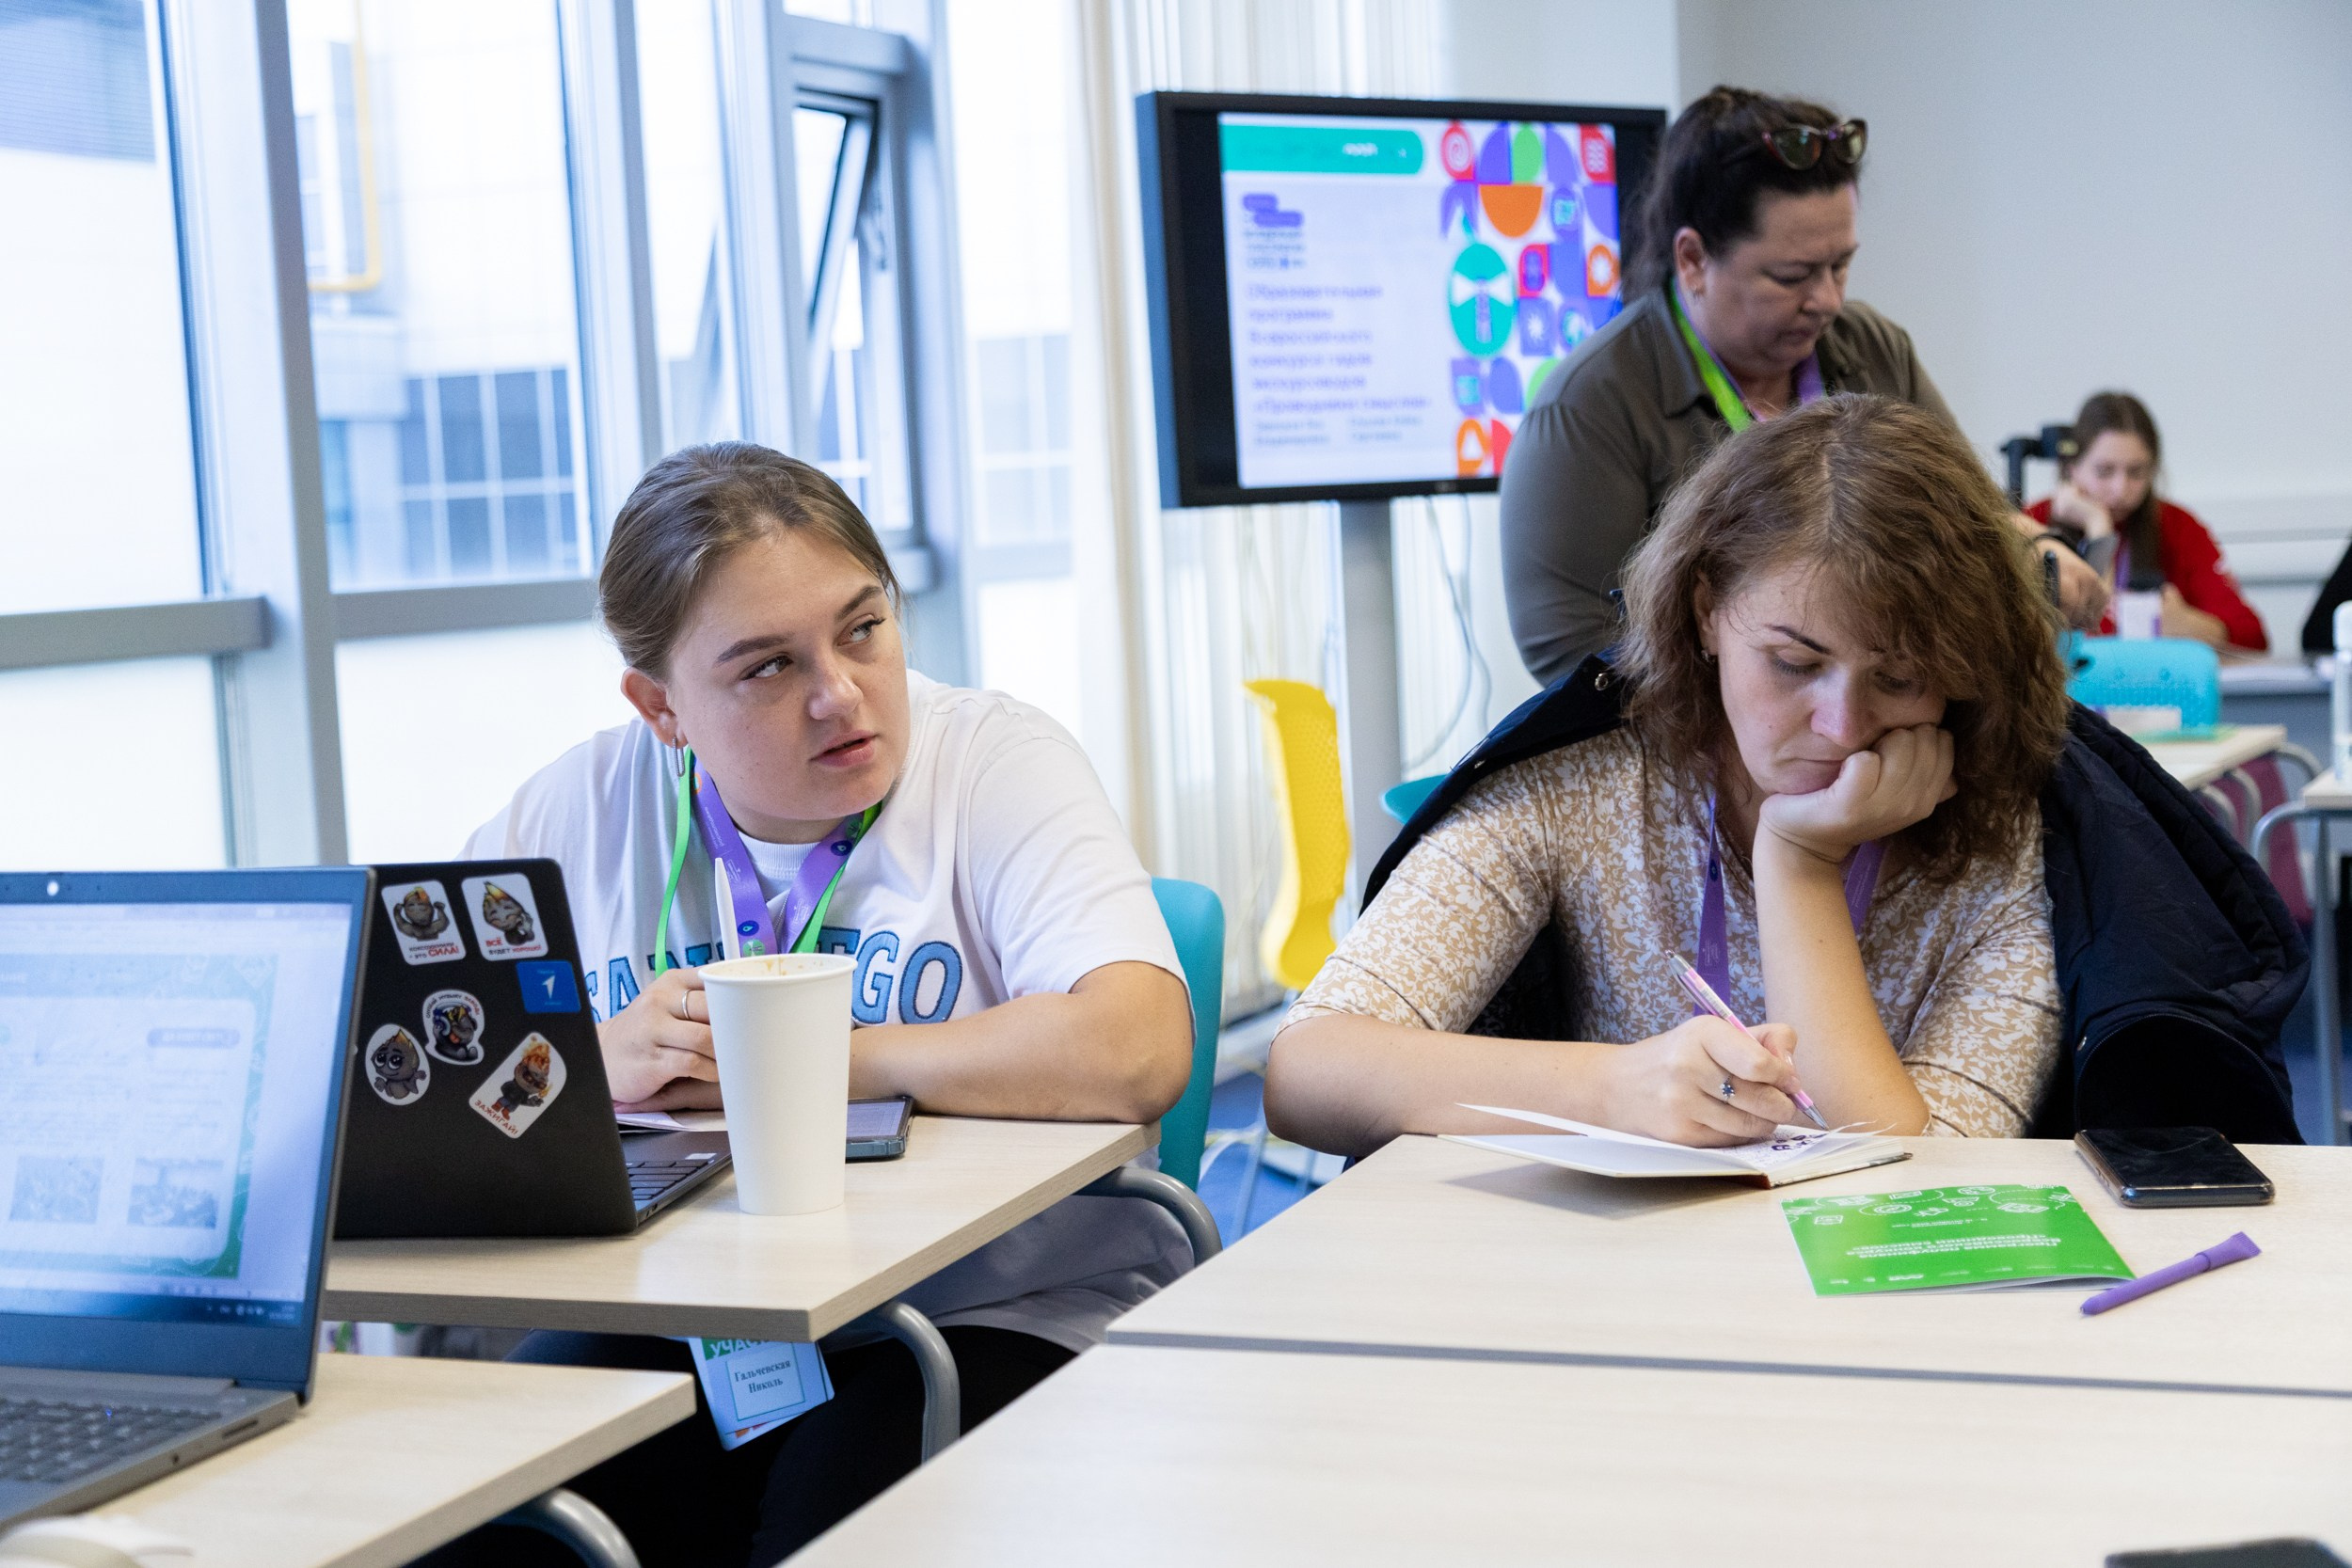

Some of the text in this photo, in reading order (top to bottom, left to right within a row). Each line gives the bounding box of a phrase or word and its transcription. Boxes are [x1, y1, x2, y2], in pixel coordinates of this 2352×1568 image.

[485, 937, 502, 947] ВСЁ
[428, 945, 459, 958] СИЛА!
[474, 1100, 518, 1135] ЗАЖИГАЙ!
[734, 1360, 791, 1383] Гальчевская
[748, 1377, 784, 1394] Николь
